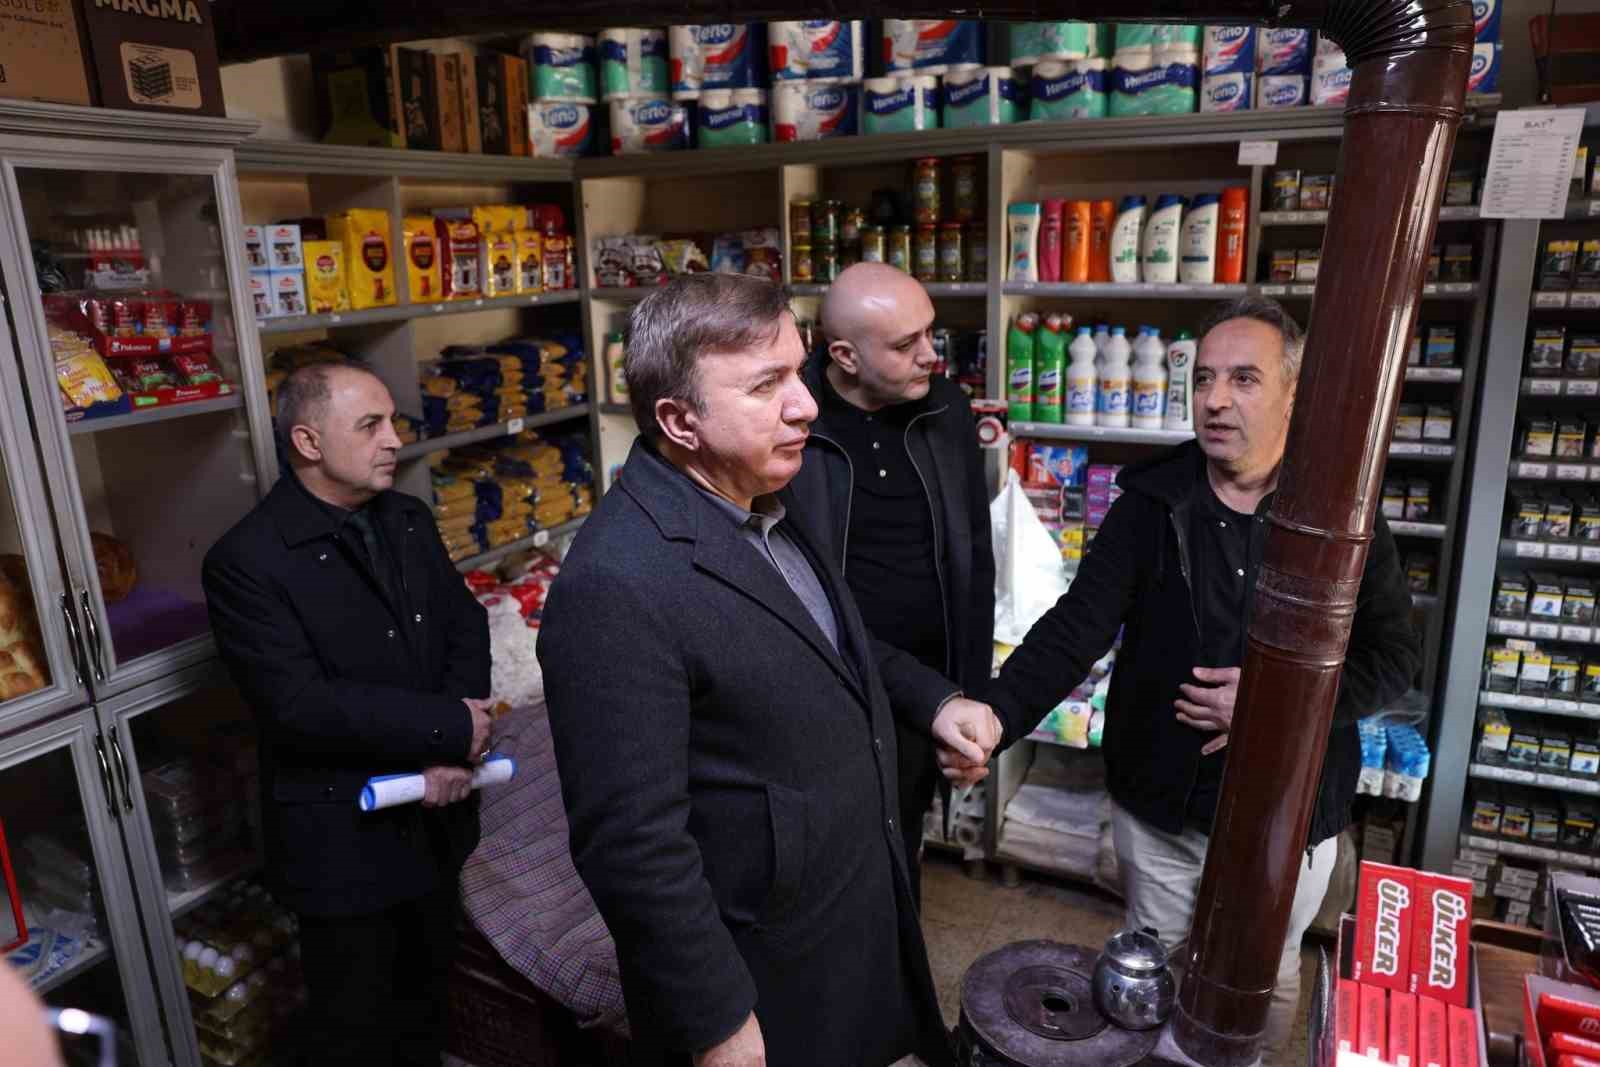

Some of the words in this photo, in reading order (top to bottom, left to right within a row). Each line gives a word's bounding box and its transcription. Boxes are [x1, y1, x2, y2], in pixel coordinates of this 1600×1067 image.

[807, 92, 840, 109] Teno
[540, 107, 577, 127] Teno
[630, 106, 669, 124] Teno
[1373, 880, 1409, 975] ÜLKER
[1430, 890, 1464, 988] ÜLKER
